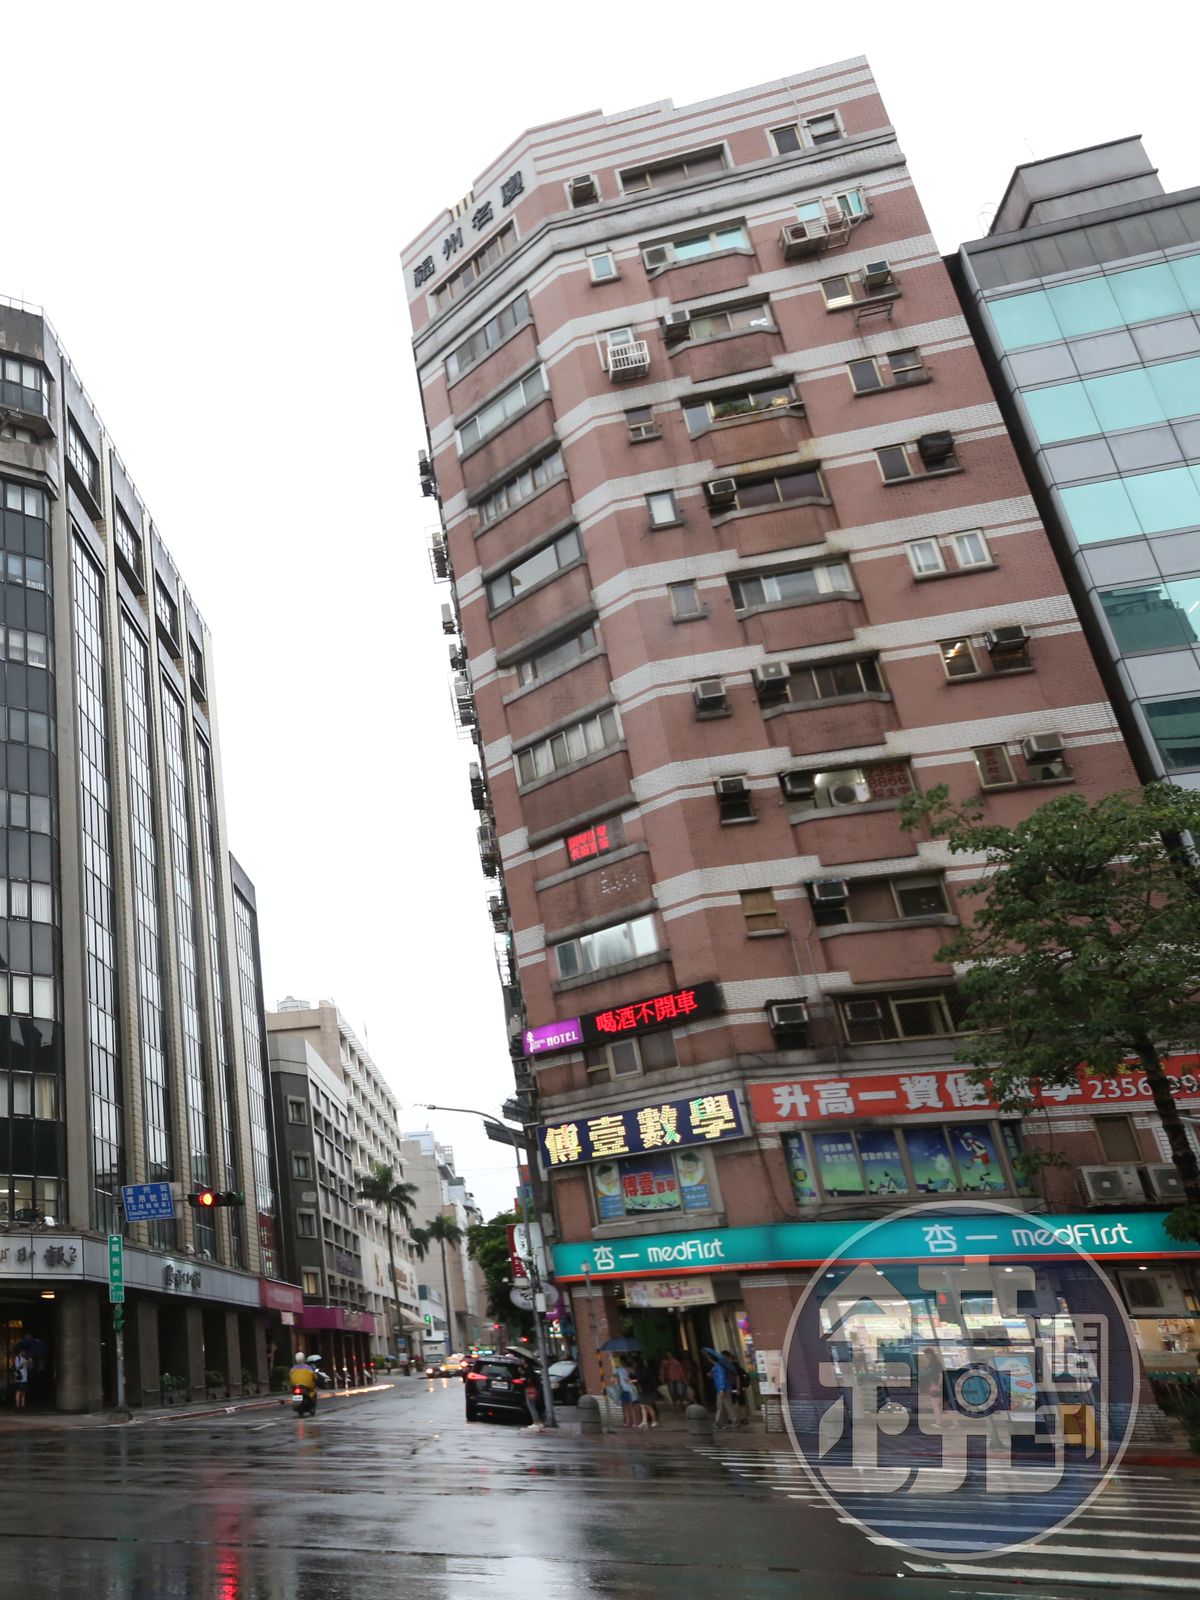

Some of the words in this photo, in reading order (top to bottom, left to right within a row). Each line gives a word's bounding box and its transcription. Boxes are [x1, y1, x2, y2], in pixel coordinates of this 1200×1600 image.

[596, 990, 698, 1033] 喝酒不開車
[544, 1094, 737, 1165] 傅壹數學
[593, 1245, 640, 1271] 杏一
[647, 1238, 725, 1263] medFirst
[922, 1223, 998, 1253] 杏一
[1011, 1222, 1133, 1247] medFirst
